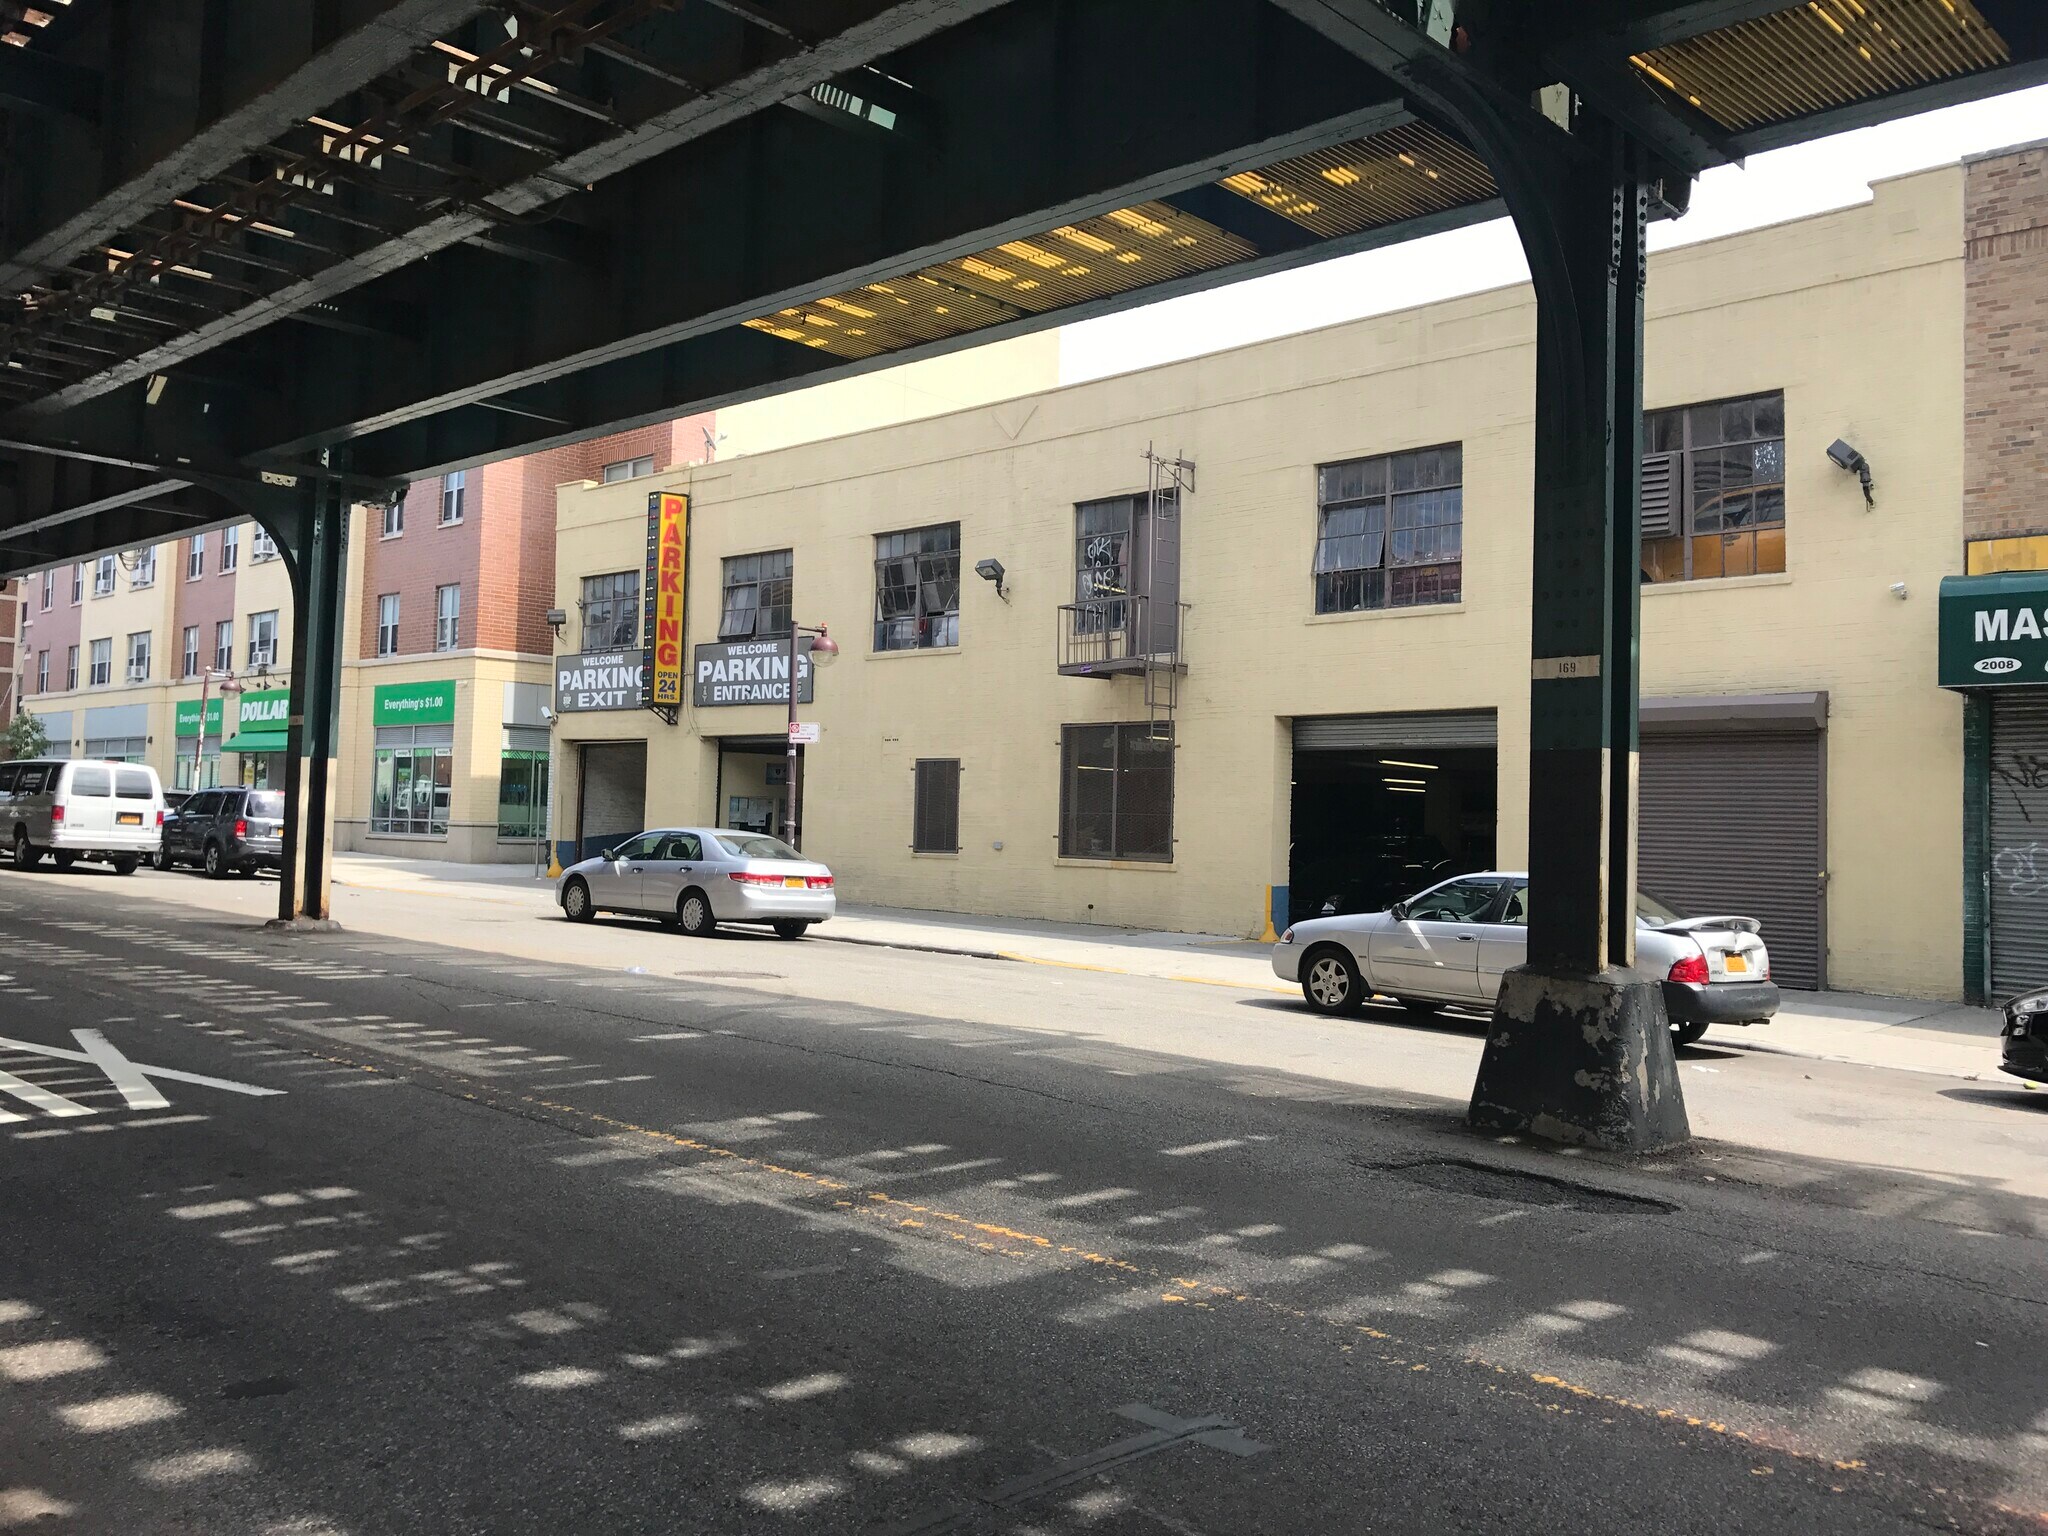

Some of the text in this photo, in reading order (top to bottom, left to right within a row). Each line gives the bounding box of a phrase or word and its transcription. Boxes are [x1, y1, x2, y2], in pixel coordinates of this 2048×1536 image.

[658, 498, 682, 666] PARKING
[1975, 608, 2048, 642] MA
[728, 643, 778, 656] WELCOME
[583, 655, 624, 667] WELCOME
[1559, 662, 1576, 673] 169
[1981, 660, 2014, 670] 2008
[657, 671, 678, 679] OPEN
[699, 655, 808, 683] PARKING
[658, 679, 676, 693] 24
[713, 682, 791, 702] ENTRANCE
[384, 696, 443, 711] Everything's $1.00
[578, 690, 627, 707] EXIT
[241, 700, 288, 721] DOLLAR
